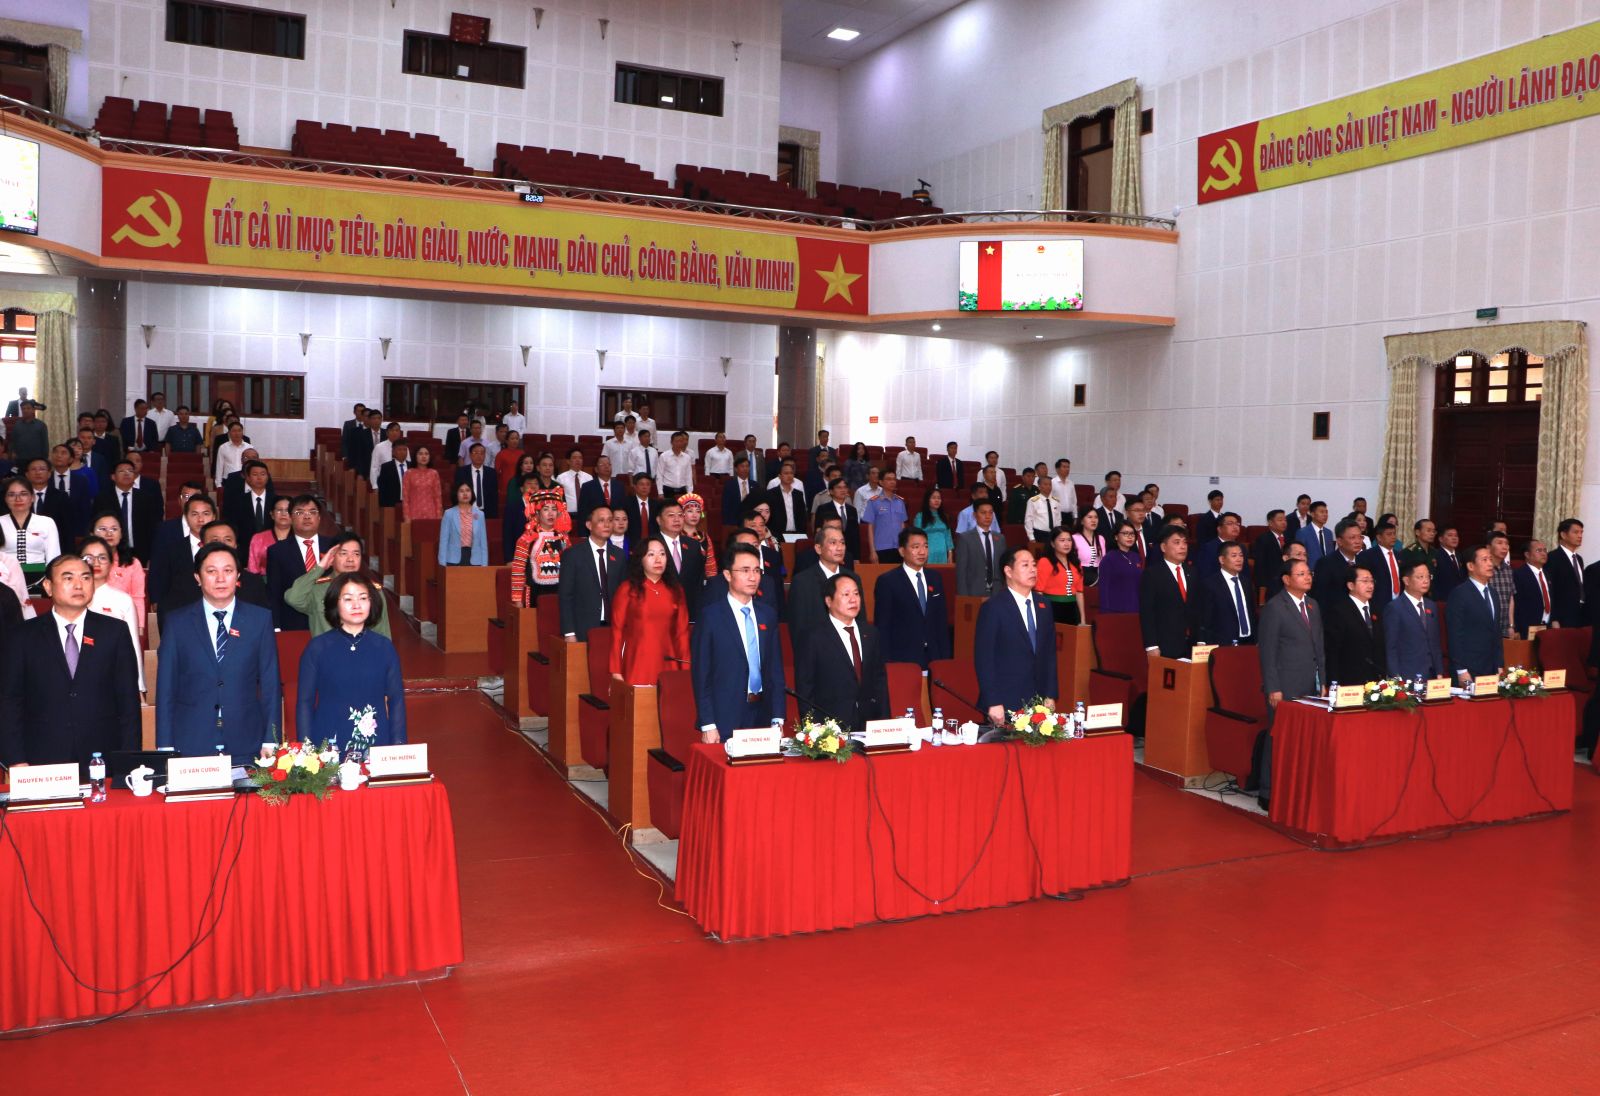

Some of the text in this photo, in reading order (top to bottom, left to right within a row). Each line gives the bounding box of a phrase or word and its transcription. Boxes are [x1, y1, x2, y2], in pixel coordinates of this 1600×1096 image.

[1260, 133, 1293, 171] ĐẢNG
[1297, 127, 1332, 166] CỘNG
[1336, 112, 1364, 153] SẢN
[1368, 106, 1398, 148] VIỆT
[1401, 99, 1437, 136] NAM
[1451, 74, 1503, 125] NGƯỜI
[1508, 66, 1557, 109] LÃNH
[212, 198, 794, 291] TẤT CẢ VÌ MỤC TIÊU: DÂN GIÀU, NƯỚC MẠNH, DÂN CHỦ, CÔNG BẰNG, VĂN MINH!
